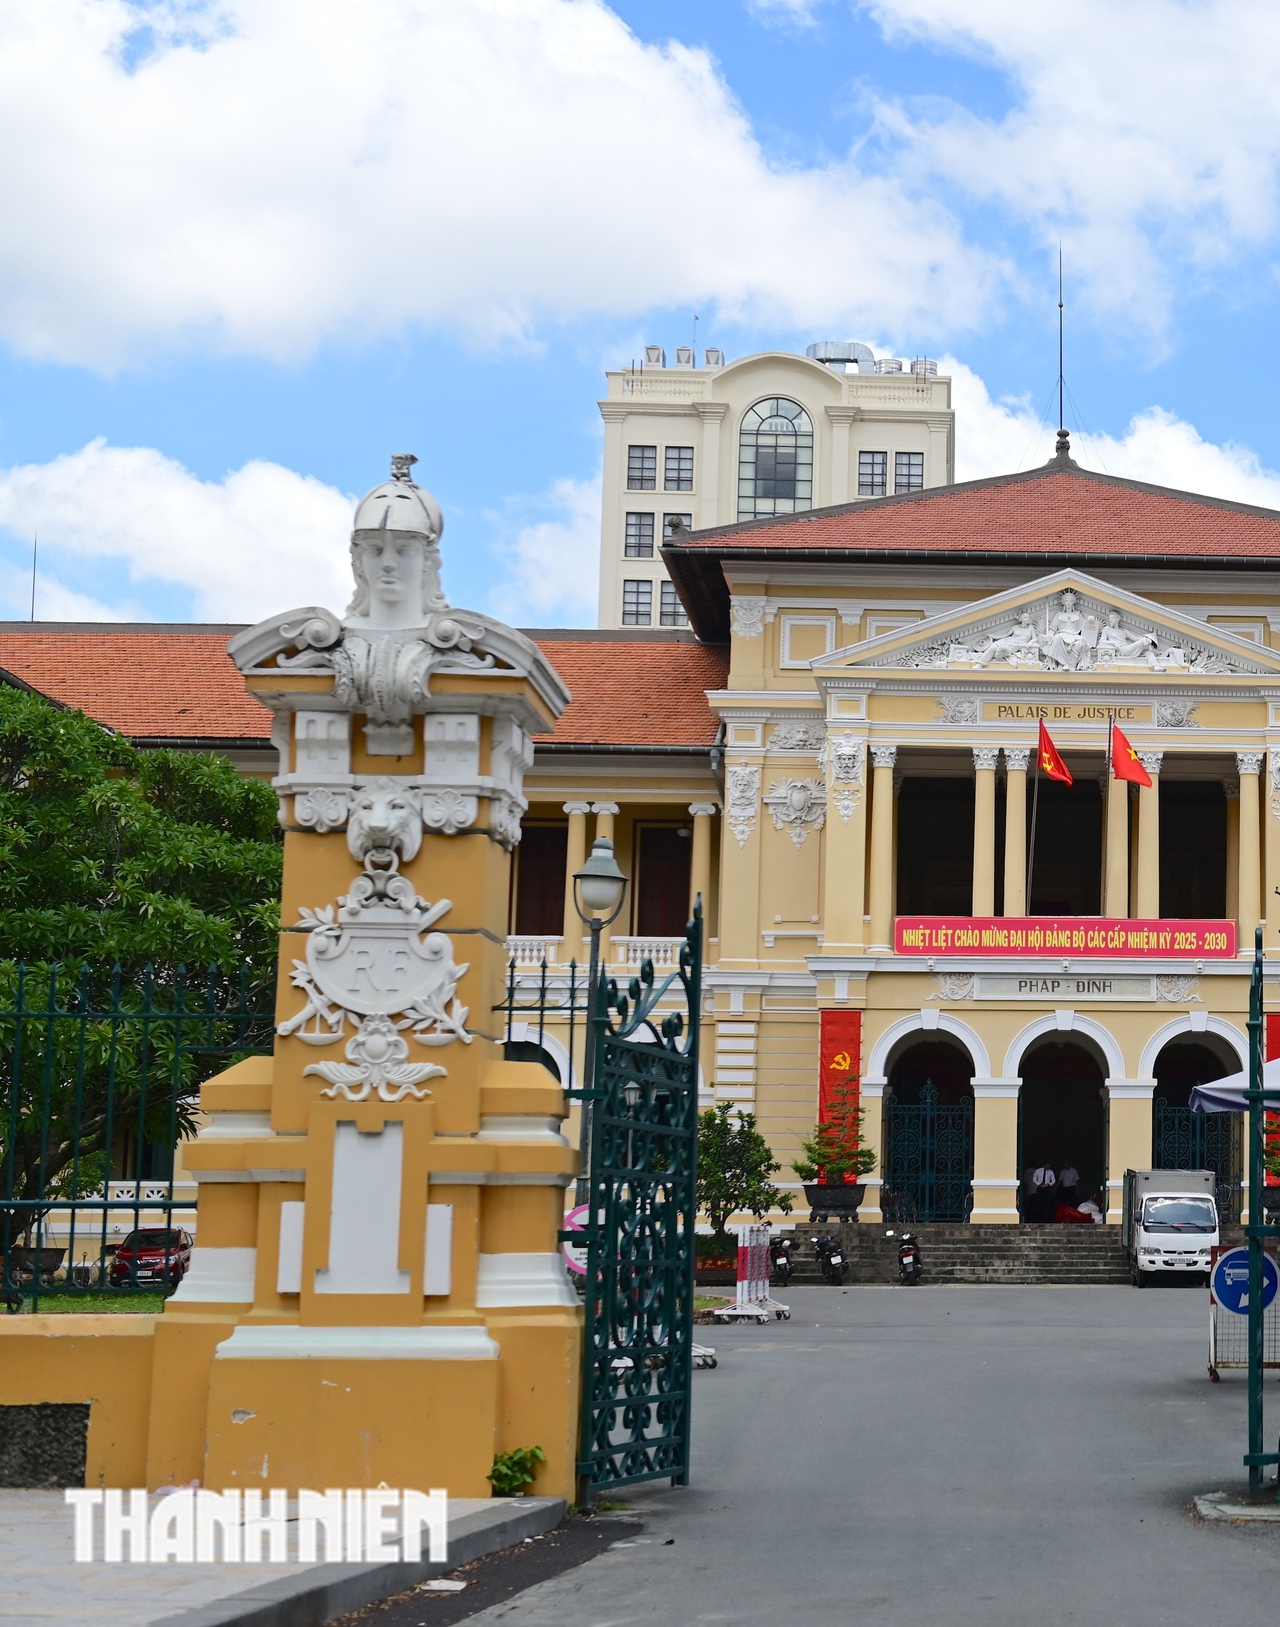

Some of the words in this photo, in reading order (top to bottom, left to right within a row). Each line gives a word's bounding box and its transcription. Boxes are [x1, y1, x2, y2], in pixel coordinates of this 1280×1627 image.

[998, 705, 1049, 718] PALAIS
[1053, 706, 1071, 719] DE
[1077, 707, 1135, 719] JUSTICE
[902, 925, 930, 950] NHIỆT
[932, 925, 953, 950] LIỆT
[954, 925, 980, 947] CHÀO
[981, 925, 1009, 947] MỪNG
[1010, 930, 1026, 950] ĐẠI
[1028, 926, 1044, 951] HỘI
[1045, 924, 1071, 948] ĐẢNG
[1072, 926, 1086, 951] BỘ
[1087, 926, 1106, 948] CÁC
[1107, 925, 1126, 948] CẤP
[1128, 927, 1158, 952] NHIỆM
[1159, 927, 1172, 949] KỲ
[1174, 932, 1197, 950] 2025
[1204, 932, 1227, 950] 2030
[1018, 979, 1060, 993] PHÁP
[1076, 979, 1113, 993] ĐÌNH
